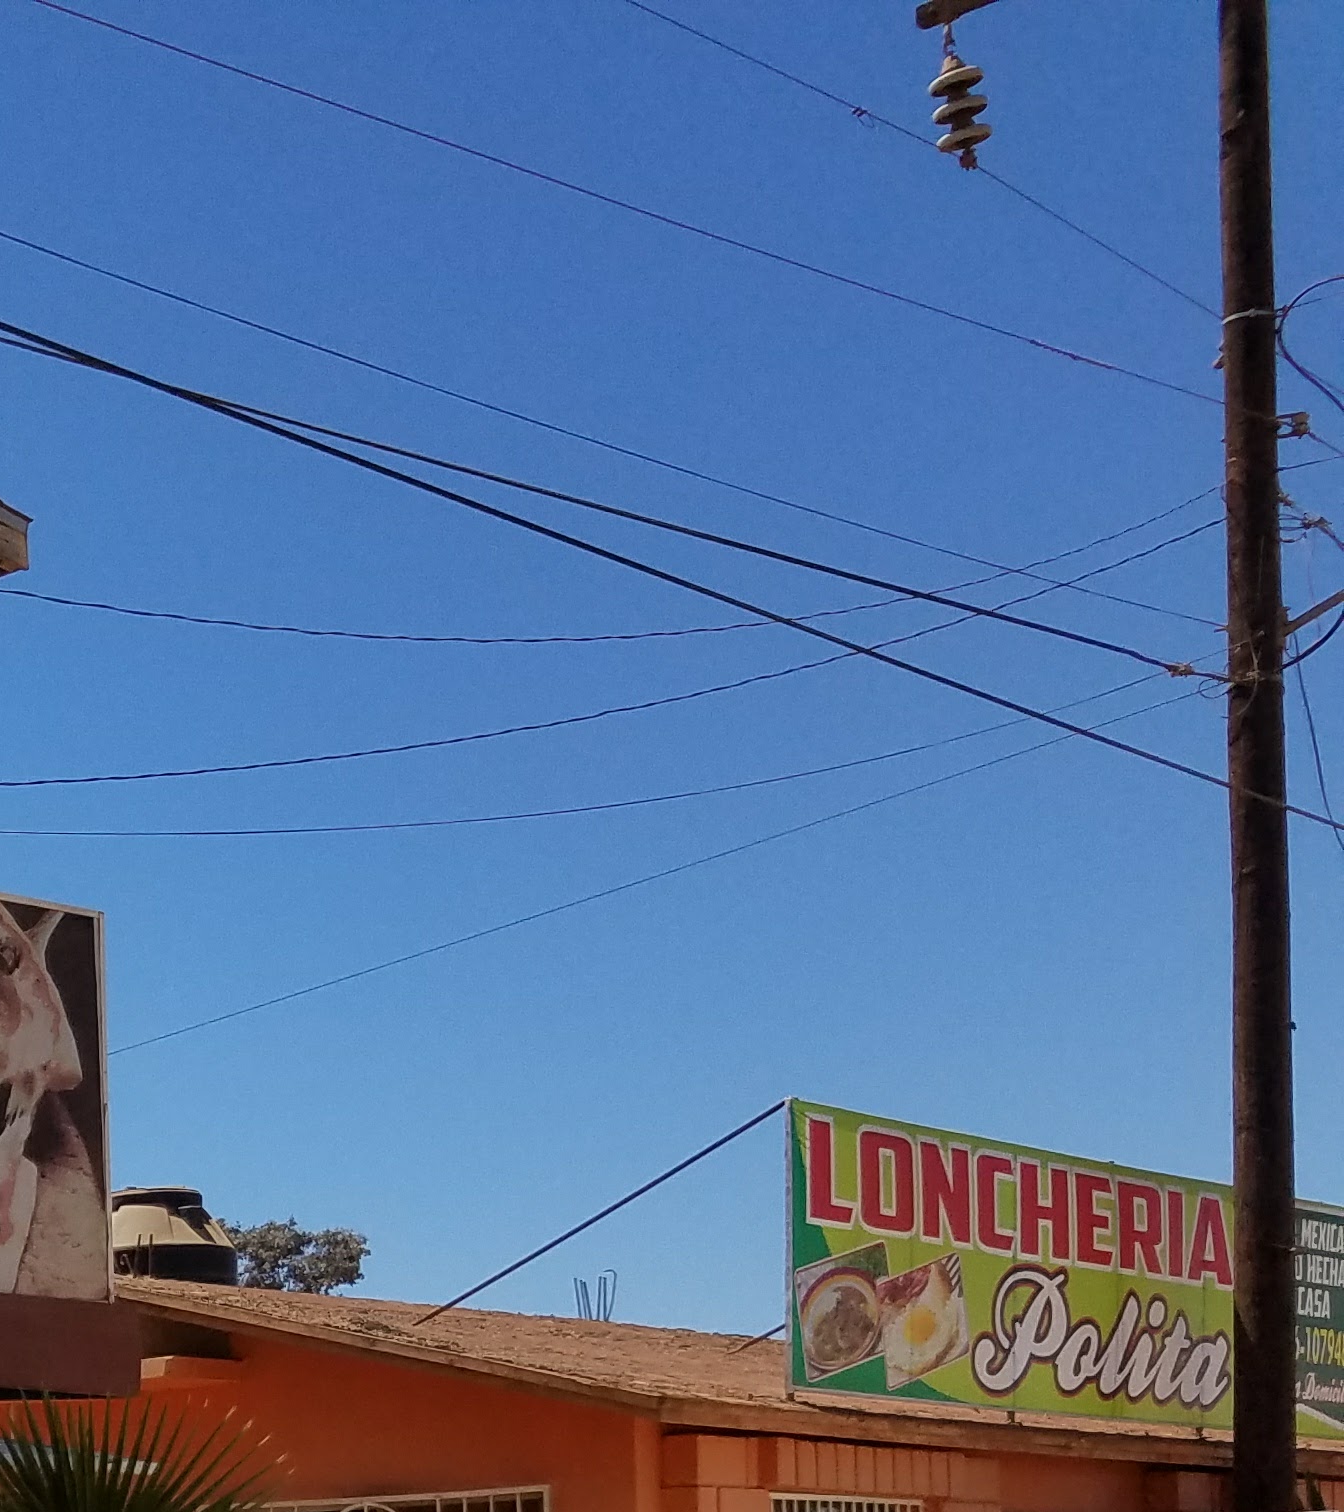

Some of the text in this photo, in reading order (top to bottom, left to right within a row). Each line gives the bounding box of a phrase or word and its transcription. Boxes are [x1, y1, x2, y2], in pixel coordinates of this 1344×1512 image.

[806, 1112, 1234, 1291] LONCHERIA
[973, 1267, 1230, 1408] Polita
[1296, 1287, 1330, 1319] CASA
